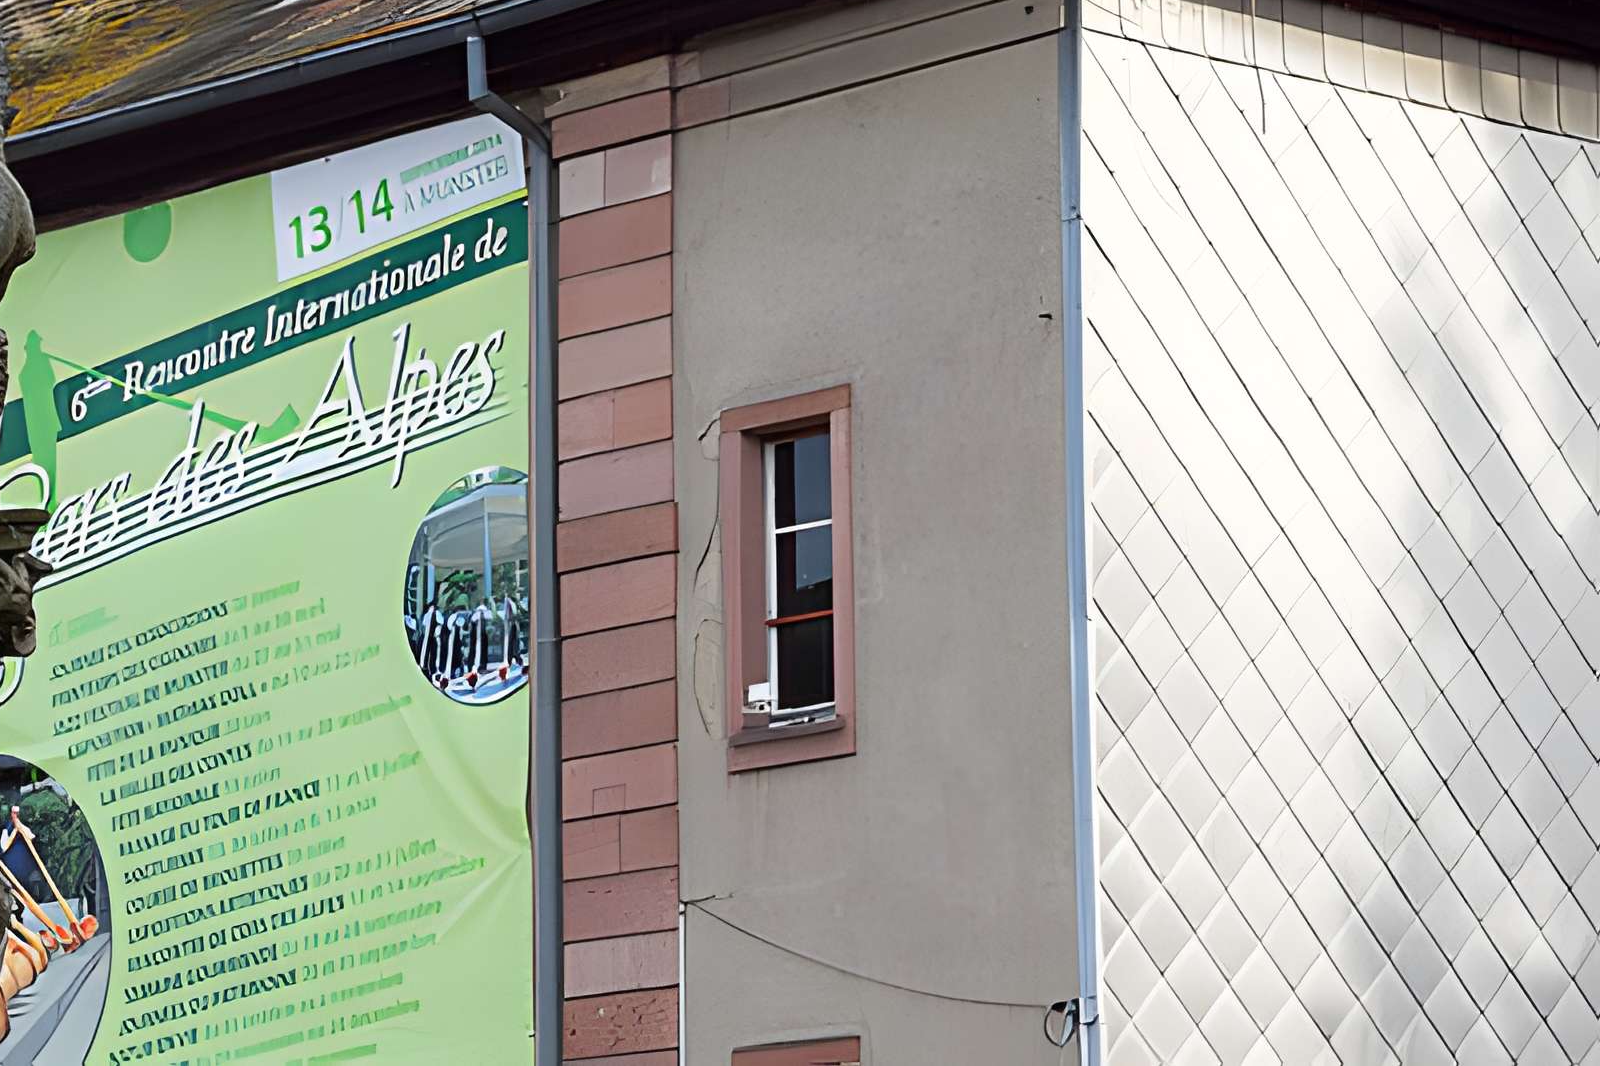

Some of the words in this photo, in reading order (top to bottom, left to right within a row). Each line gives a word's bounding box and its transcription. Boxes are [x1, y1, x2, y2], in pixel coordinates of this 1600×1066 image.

[122, 326, 256, 402] Rencontre
[263, 233, 465, 347] Internationale
[474, 217, 509, 263] de
[151, 397, 259, 524] des
[284, 321, 507, 490] Alpes
